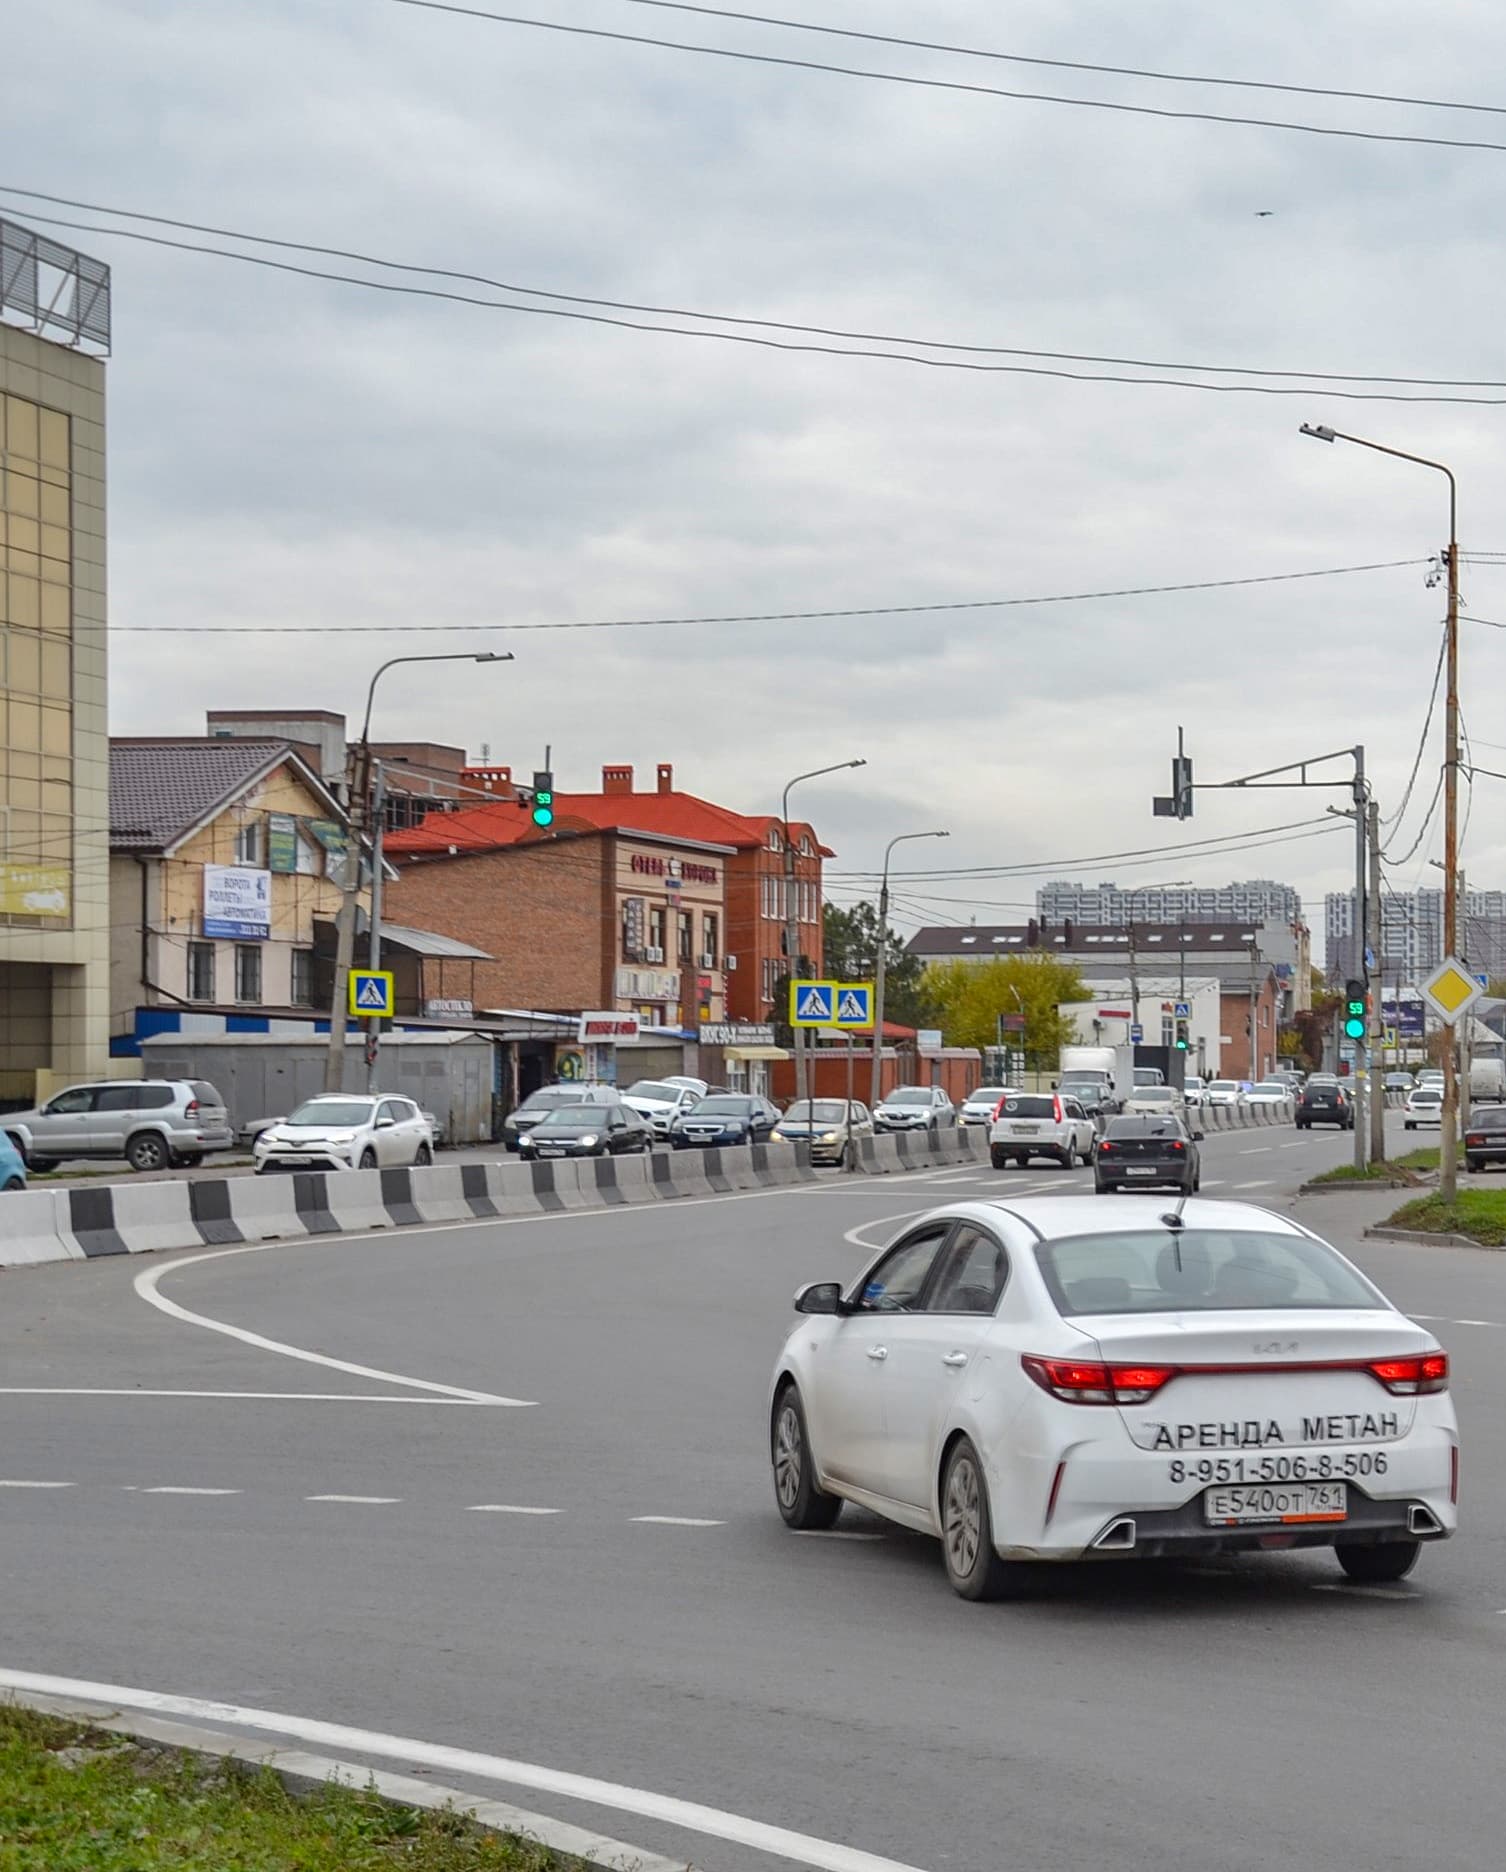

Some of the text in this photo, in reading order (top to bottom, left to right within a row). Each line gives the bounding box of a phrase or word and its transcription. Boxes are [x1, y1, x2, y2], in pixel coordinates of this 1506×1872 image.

[537, 792, 550, 804] 59
[1349, 1002, 1363, 1014] 59
[1153, 1412, 1399, 1450] АРЕНДА МЕТАН
[1169, 1451, 1388, 1484] 8-951-506-8-506
